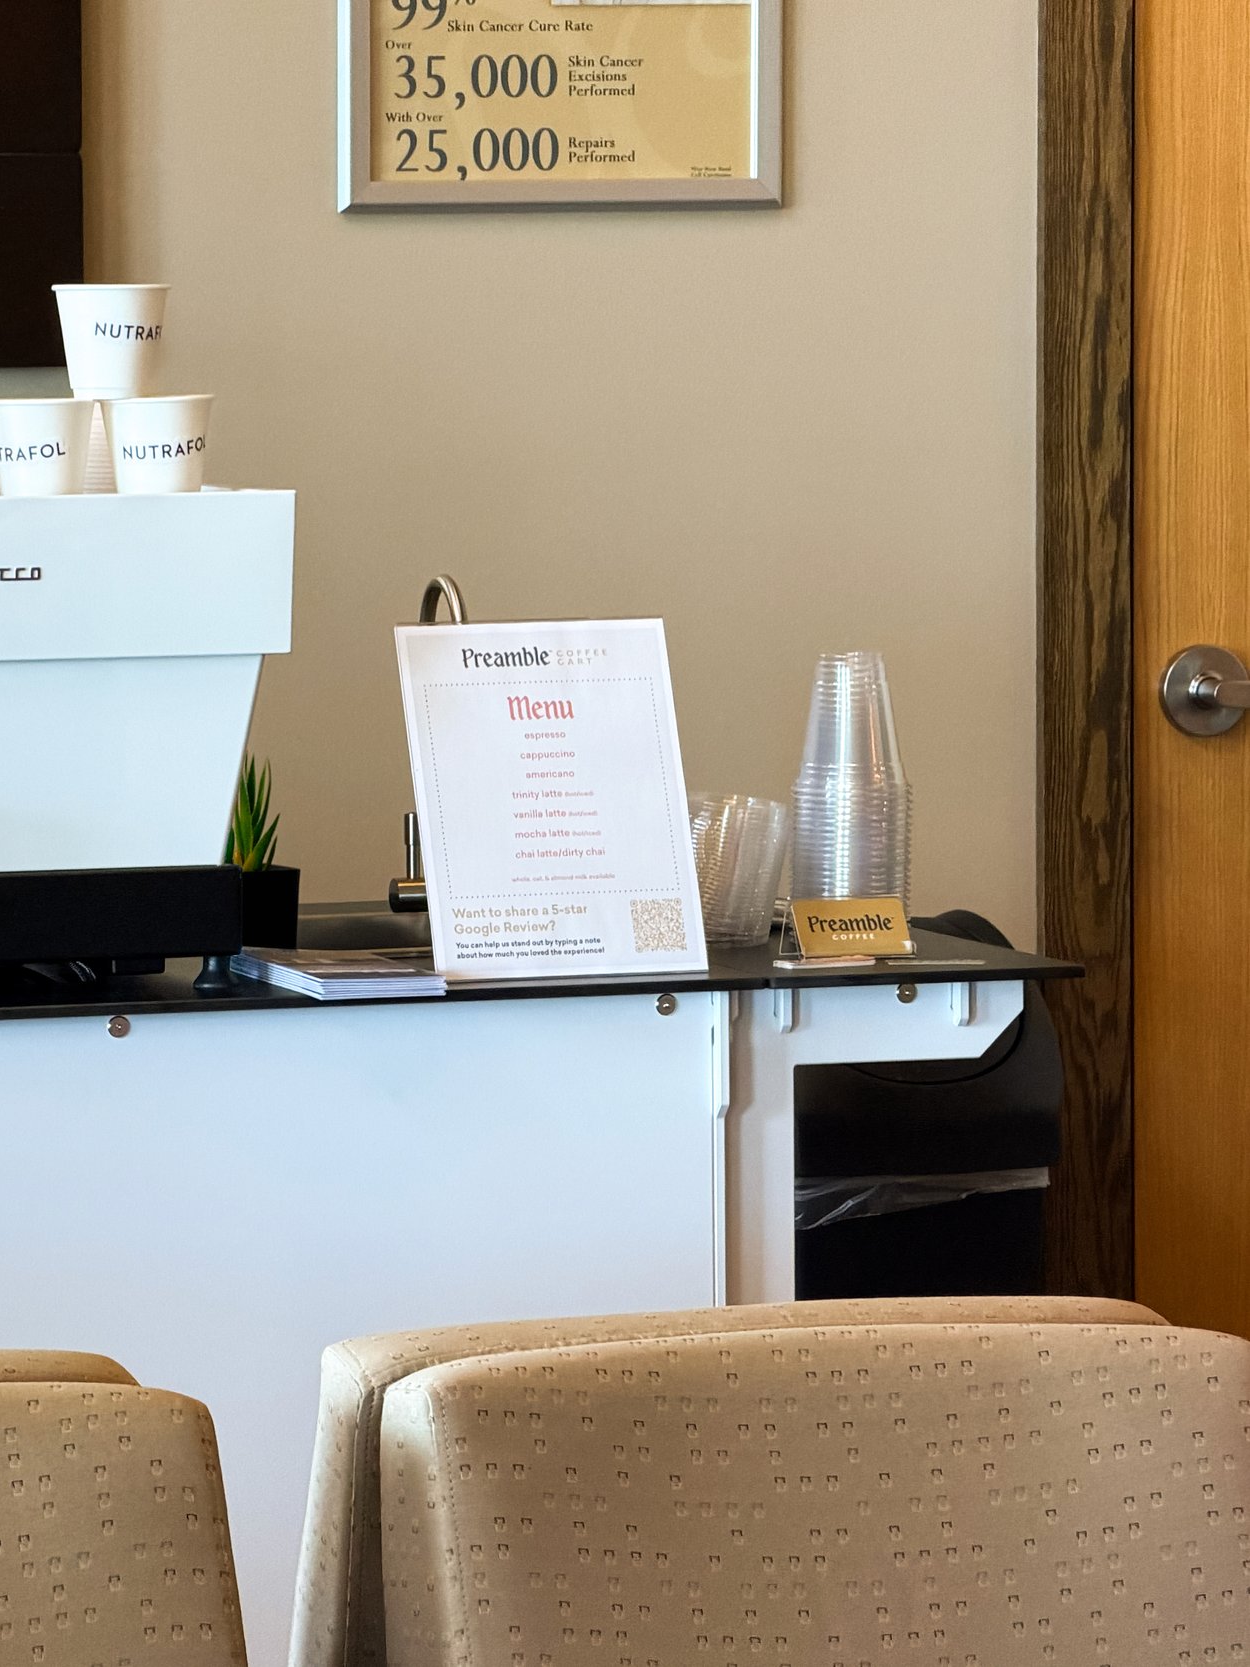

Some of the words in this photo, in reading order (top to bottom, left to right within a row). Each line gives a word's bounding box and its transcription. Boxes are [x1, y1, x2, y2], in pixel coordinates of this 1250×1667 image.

[447, 20, 475, 32] Skin
[479, 20, 524, 32] Cancer
[528, 20, 560, 32] Cure
[565, 20, 593, 32] Rate
[385, 40, 412, 49] Over
[568, 56, 595, 68] Skin
[599, 55, 643, 68] Cancer
[393, 54, 558, 110] 35,000
[568, 70, 627, 82] Excisions
[568, 84, 636, 97] Performed
[385, 112, 412, 123] With
[416, 112, 443, 122] Over
[568, 136, 616, 151] Repairs
[395, 128, 559, 181] 25,000
[568, 151, 636, 163] Performed
[461, 647, 551, 668] Preamble
[556, 649, 607, 657] COFFEE
[557, 658, 592, 666] CART
[507, 695, 575, 721] Menu
[524, 731, 566, 740] espresso
[520, 750, 576, 760] cappuccino
[525, 770, 575, 778] americano
[512, 790, 539, 800] trinity
[541, 789, 563, 798] latte
[513, 809, 543, 818] vanilla
[545, 808, 567, 818] latte
[515, 829, 547, 838] mocha
[549, 828, 570, 837] latte
[515, 849, 535, 859] chai
[537, 847, 584, 858] latte/dirty
[585, 846, 606, 856] chai
[452, 908, 487, 919] Want
[489, 907, 502, 918] to
[505, 905, 539, 917] share
[542, 907, 549, 915] a
[551, 904, 588, 915] 5-star
[454, 922, 501, 937] Google
[504, 920, 556, 933] Review?
[808, 914, 894, 933] Preamble
[485, 940, 500, 949] help
[511, 938, 531, 947] stand
[532, 938, 544, 946] out
[545, 938, 553, 947] by
[555, 938, 578, 947] typing
[457, 951, 478, 959] about
[479, 950, 494, 958] how
[495, 949, 515, 957] much
[516, 950, 529, 958] you
[530, 948, 550, 956] loved
[563, 946, 605, 956] experience!
